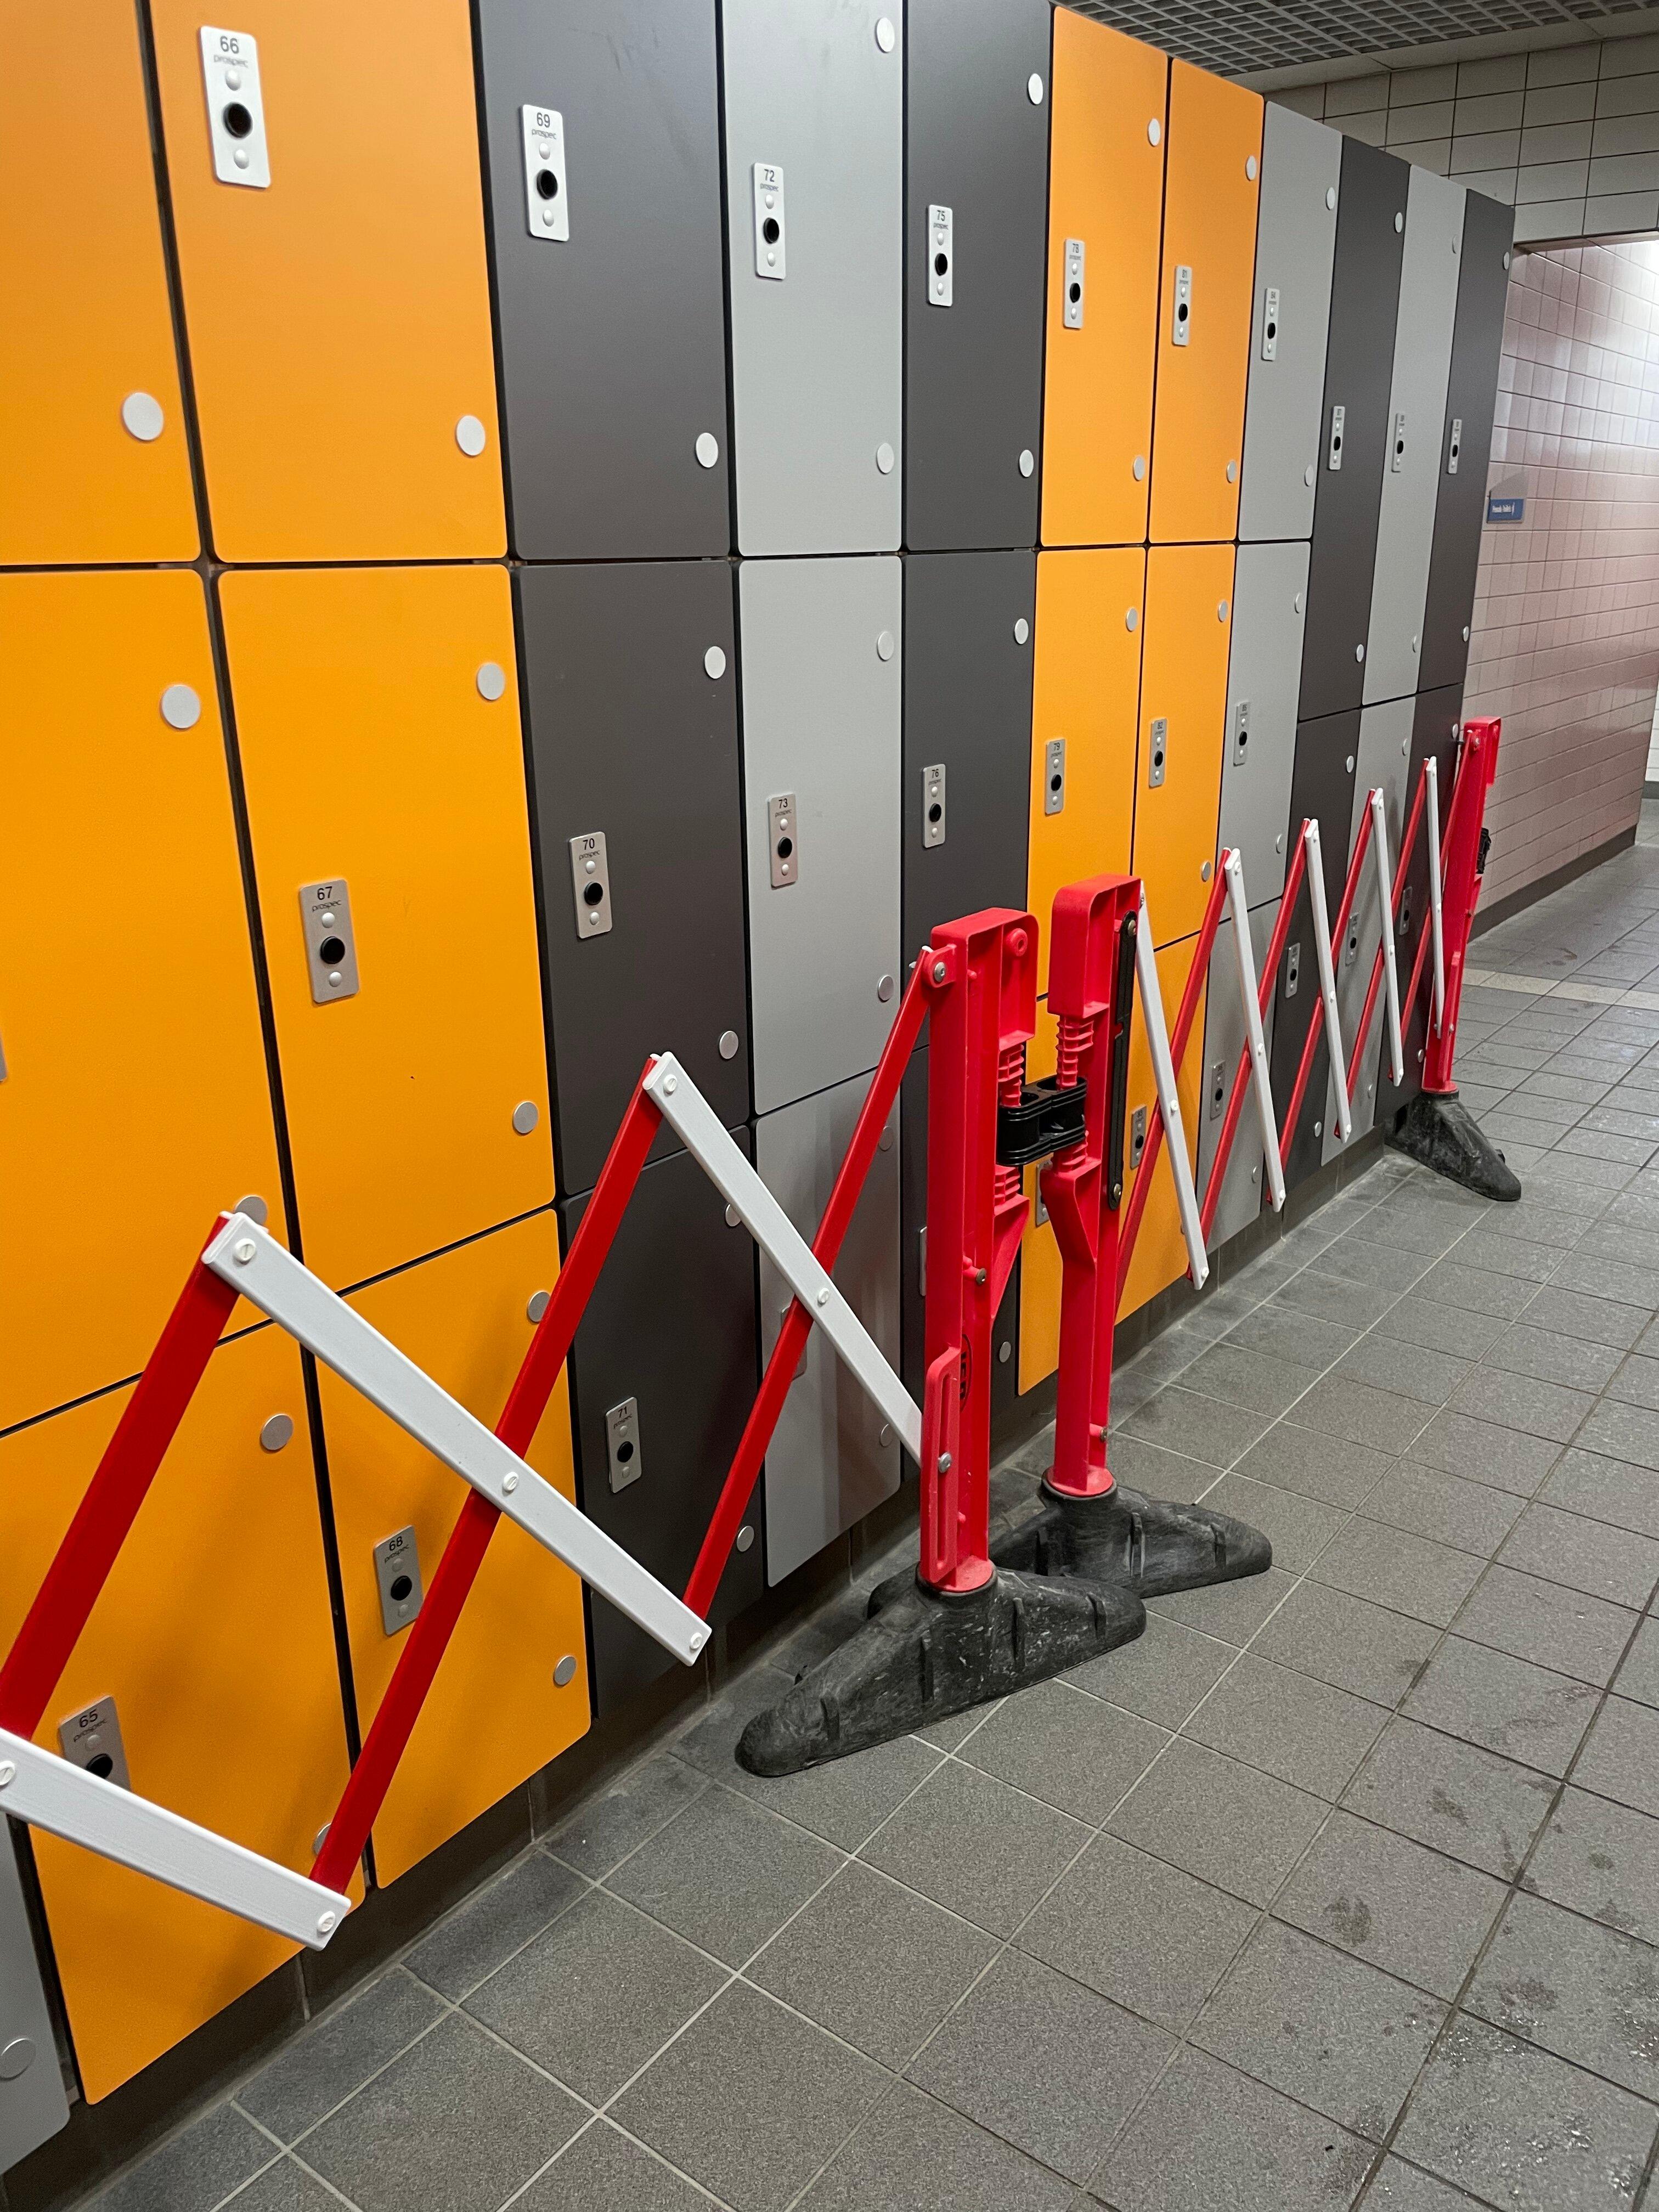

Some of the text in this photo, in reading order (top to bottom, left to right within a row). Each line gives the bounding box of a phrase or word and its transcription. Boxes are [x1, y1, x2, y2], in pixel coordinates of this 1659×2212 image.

[220, 35, 240, 54] 66
[537, 112, 550, 128] 69
[764, 168, 775, 183] 72
[937, 210, 945, 222] 75
[1053, 742, 1060, 751] 79
[932, 768, 939, 778] 76
[778, 798, 788, 809] 73
[583, 838, 595, 850] 70
[317, 886, 332, 900] 67
[618, 1406, 627, 1418] 71
[389, 1536, 403, 1551] 68
[79, 1708, 98, 1728] 65
